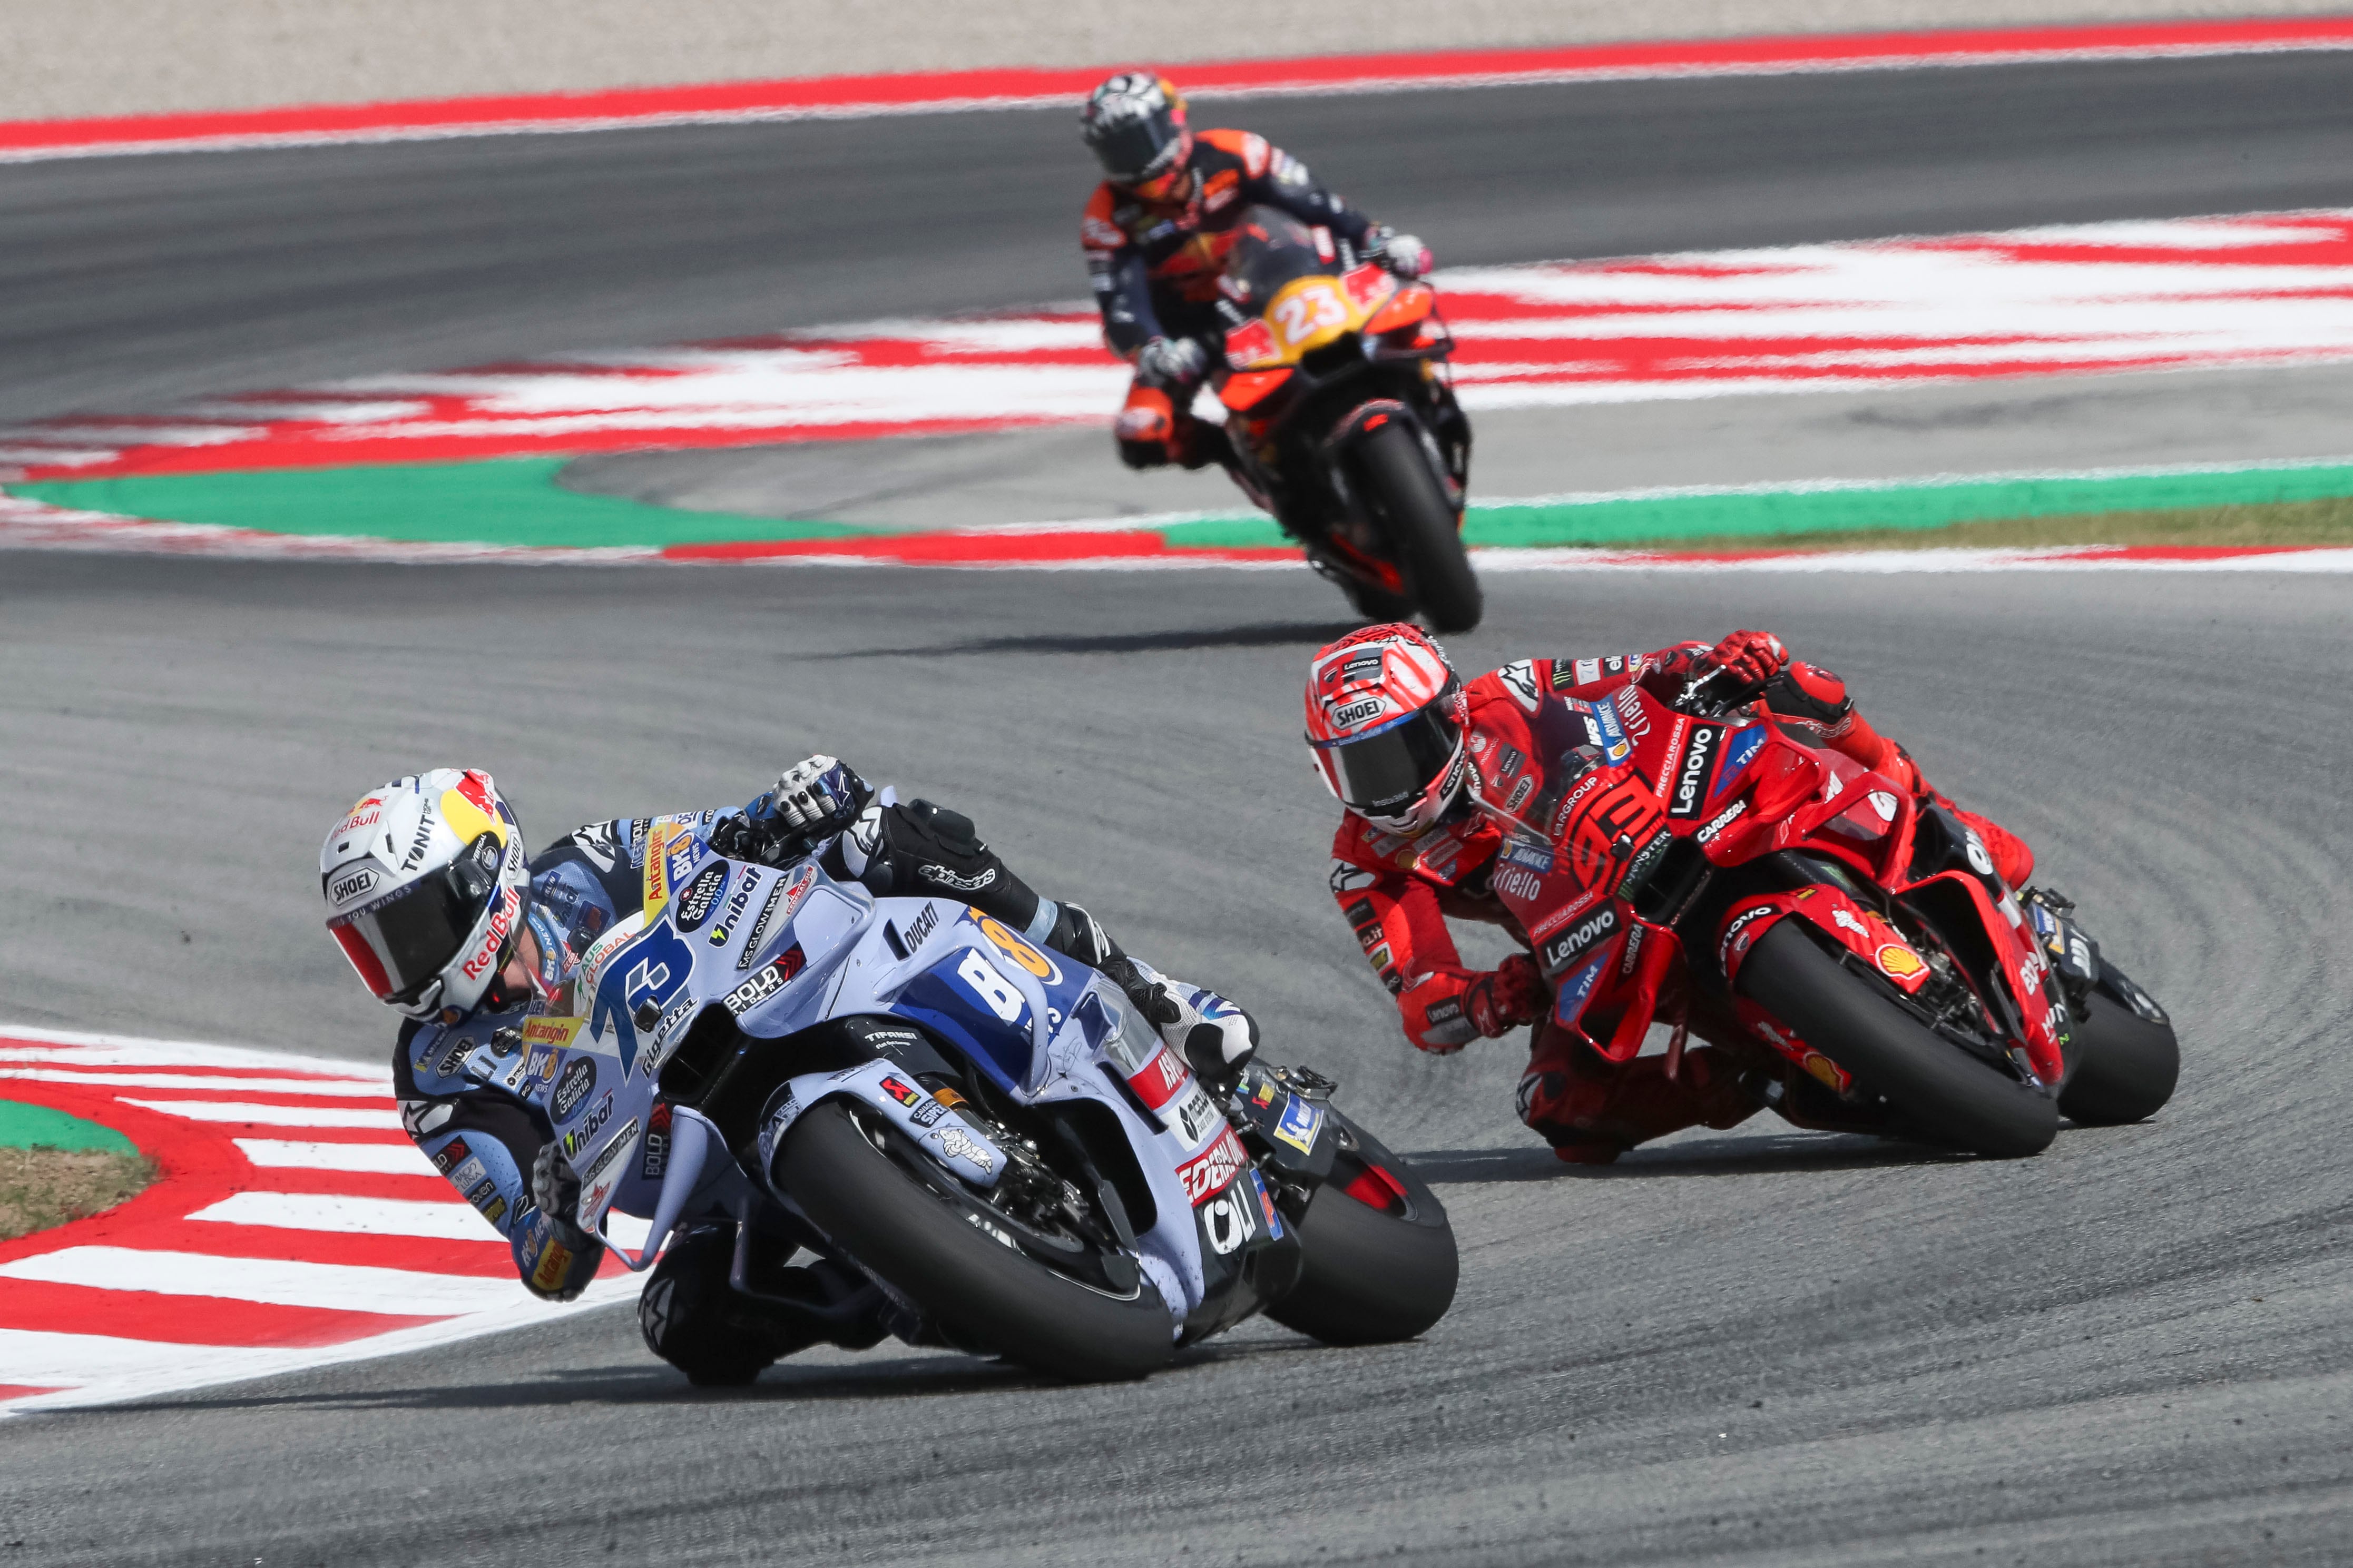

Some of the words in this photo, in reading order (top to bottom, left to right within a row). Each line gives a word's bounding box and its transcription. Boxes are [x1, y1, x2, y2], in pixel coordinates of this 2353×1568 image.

[1273, 284, 1349, 344] 23
[1344, 659, 1379, 670] Lenovo
[1337, 700, 1379, 726] SHOEI
[1655, 717, 1685, 798] FRECCIAROSSA
[1671, 728, 1712, 814] Lenovo
[1736, 738, 1764, 764] TIM
[349, 811, 380, 829] Bull
[1697, 800, 1747, 843] CARRERA
[472, 834, 487, 863] VERTICAL
[507, 836, 521, 873] SHOEI
[692, 842, 700, 863] NEWS
[333, 871, 372, 902] SHOEI
[347, 907, 366, 923] YOU
[370, 884, 411, 913] WINGS
[681, 871, 714, 921] Estrella
[692, 874, 723, 920] Galicia
[708, 866, 763, 948] Unibat
[787, 875, 808, 915] FEDERAL
[463, 940, 502, 981] Red
[491, 884, 521, 936] Bull
[739, 951, 753, 968] MS
[749, 913, 769, 950] GLOW
[769, 877, 787, 905] MEN
[904, 901, 940, 955] DUCATI
[1546, 910, 1615, 967] Lenovo
[581, 942, 604, 973] AUS
[585, 931, 636, 985] GLOBAL
[957, 909, 1056, 1024] B8
[1623, 924, 1644, 974] CARRERA
[723, 965, 779, 1009] BOLD
[1576, 965, 1598, 998] TIM
[525, 1019, 570, 1044] Antangin
[439, 1039, 473, 1073] SHOEI
[534, 1083, 549, 1093] NEWS
[556, 1064, 589, 1105] Estrella
[560, 1078, 591, 1115] Galicia
[561, 1091, 615, 1160] Unibat
[434, 1153, 447, 1171] LD
[645, 1133, 663, 1176] BOLD
